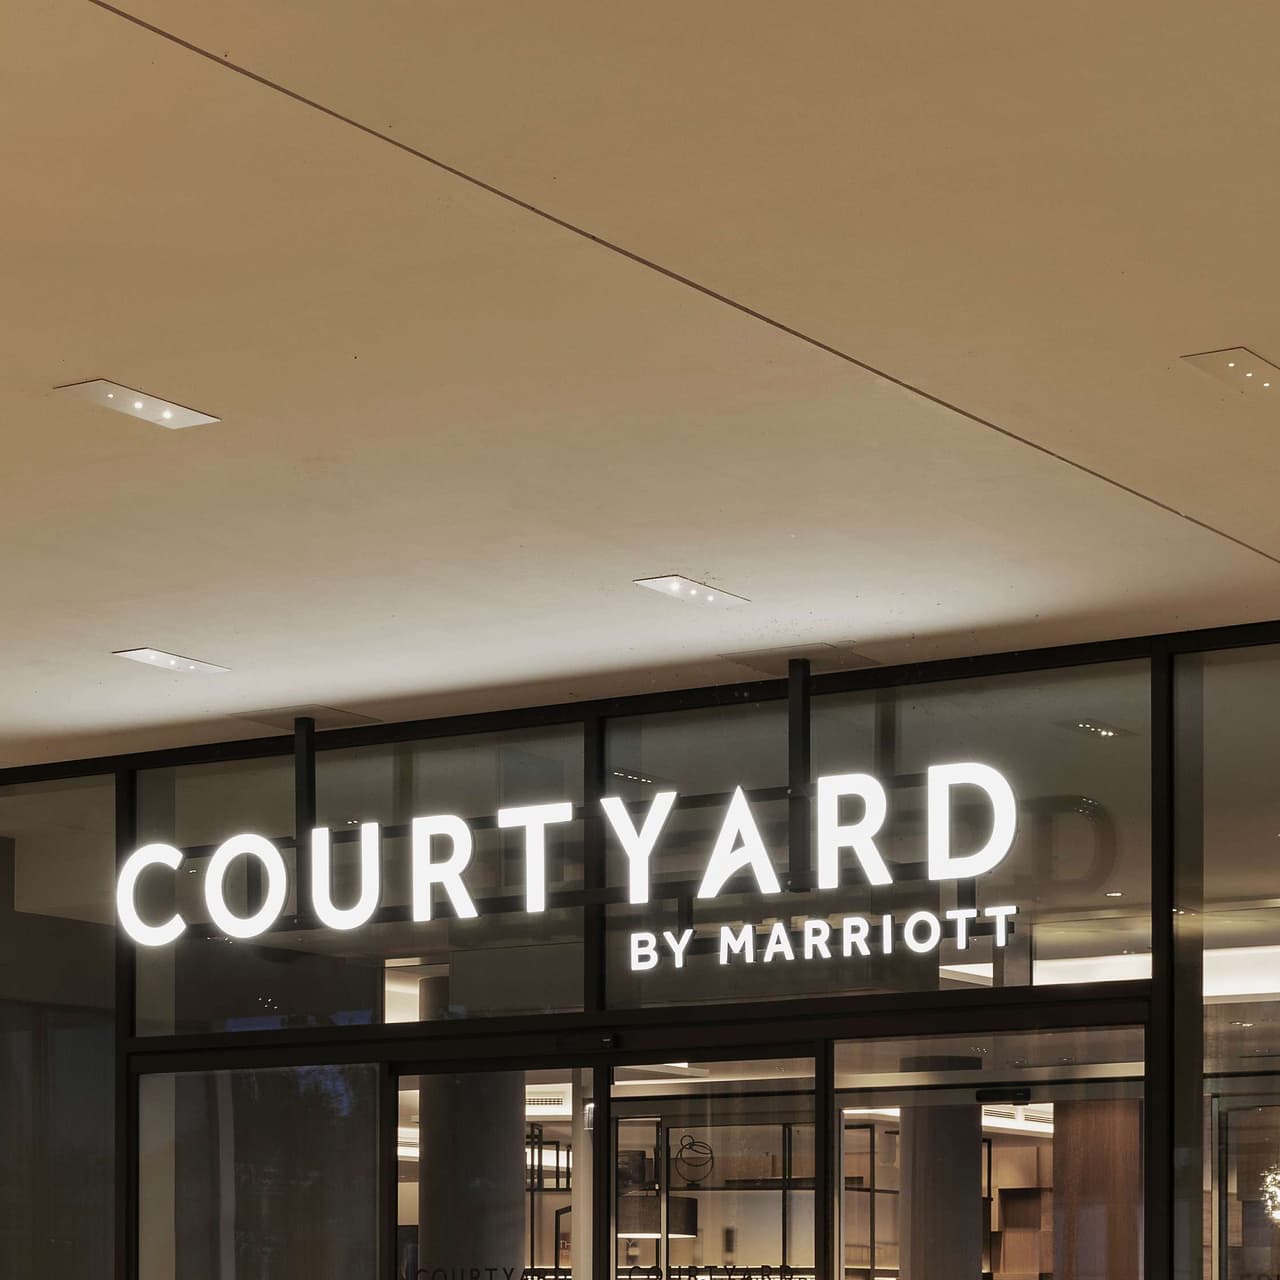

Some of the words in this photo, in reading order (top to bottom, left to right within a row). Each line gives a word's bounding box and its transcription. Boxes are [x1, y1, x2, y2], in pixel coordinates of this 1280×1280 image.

[117, 762, 1018, 947] COURTYARD
[631, 928, 695, 971] BY
[721, 905, 1018, 965] MARRIOTT
